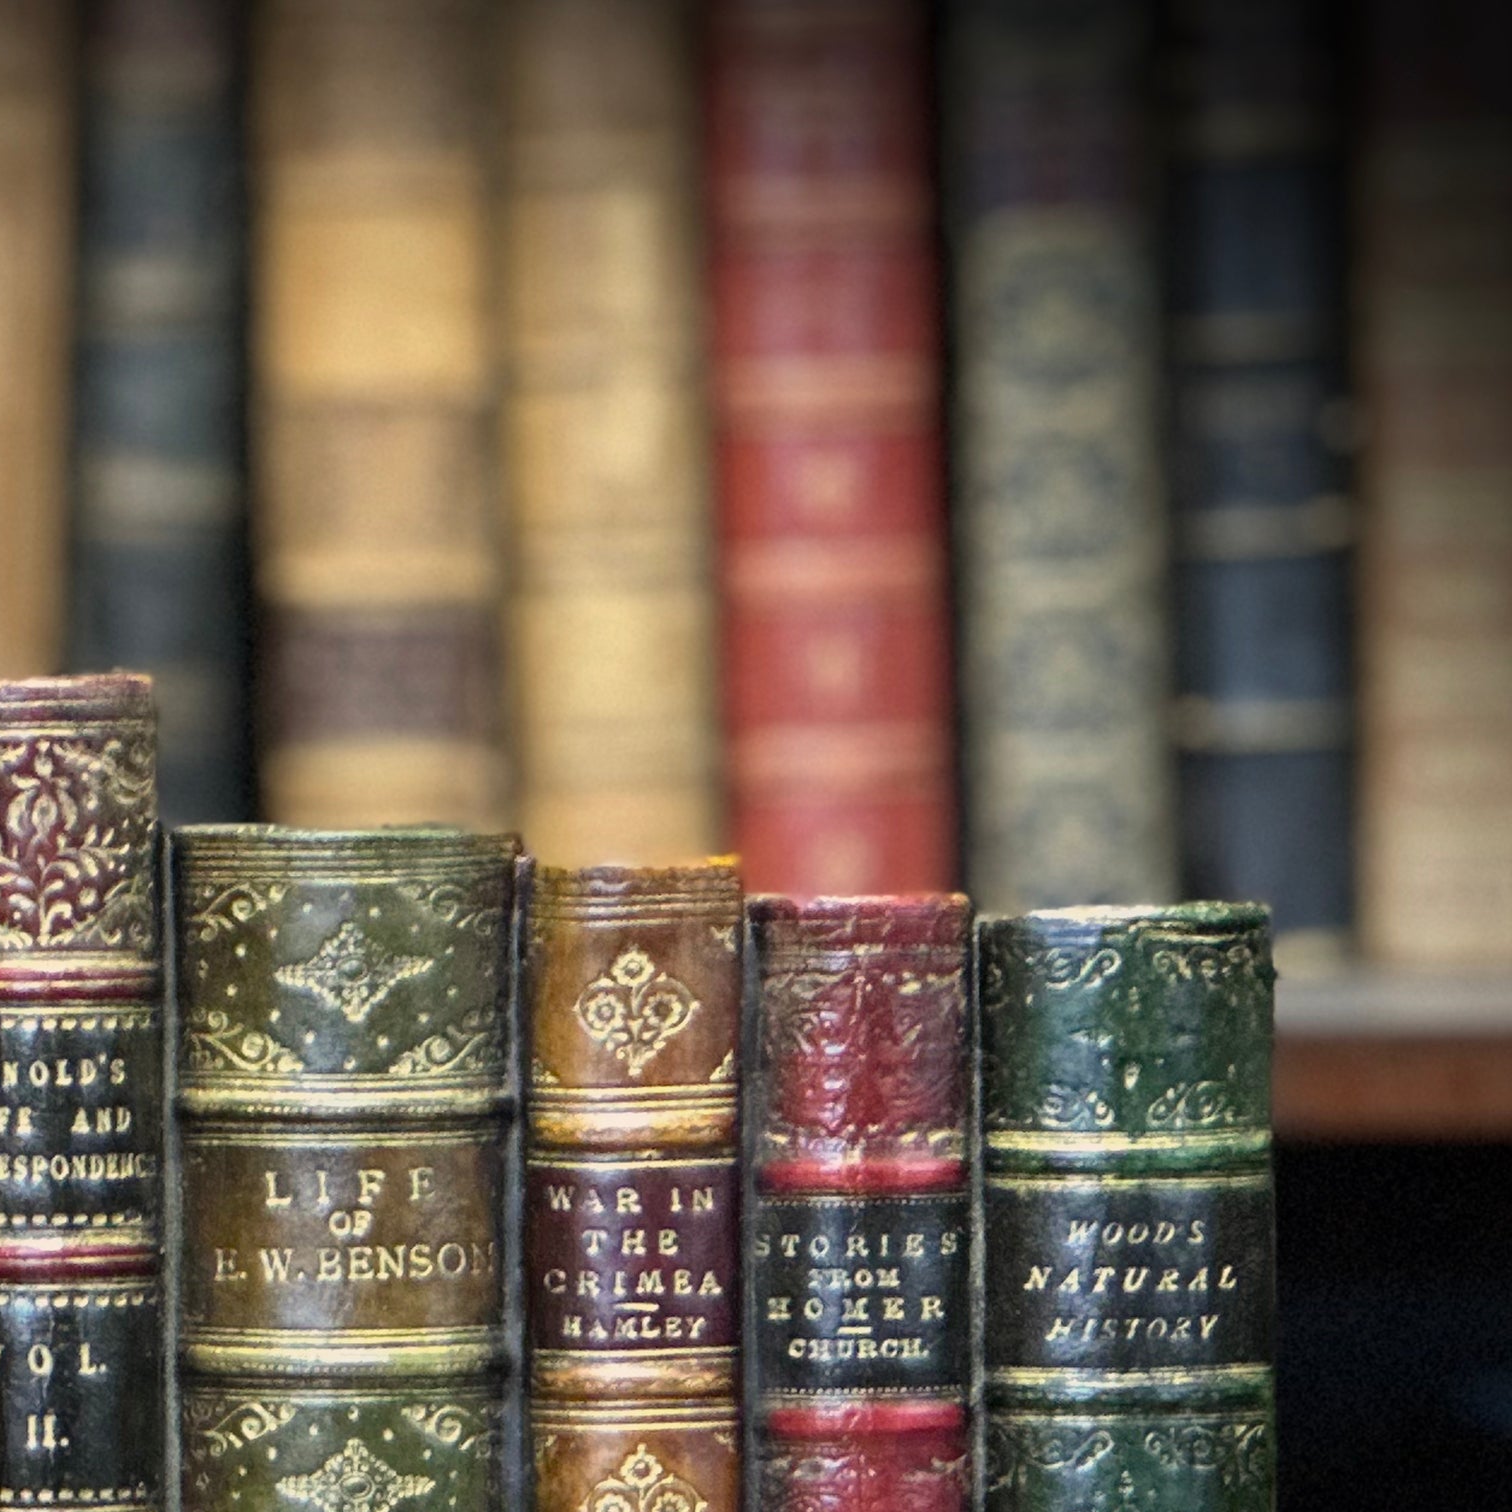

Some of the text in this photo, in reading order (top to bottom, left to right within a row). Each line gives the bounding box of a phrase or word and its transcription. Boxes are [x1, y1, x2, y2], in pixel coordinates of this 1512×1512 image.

[71, 1107, 133, 1135] AND
[263, 1166, 437, 1208] LIFE
[548, 1185, 716, 1214] WAR IN
[328, 1210, 375, 1238] OF
[583, 1229, 680, 1256] THE
[753, 1232, 959, 1258] STORIES
[1023, 1264, 1237, 1293] NATURAL
[767, 1295, 945, 1321] HOMER
[563, 1315, 707, 1341] HAMLEY
[1044, 1313, 1221, 1342] HISTORY
